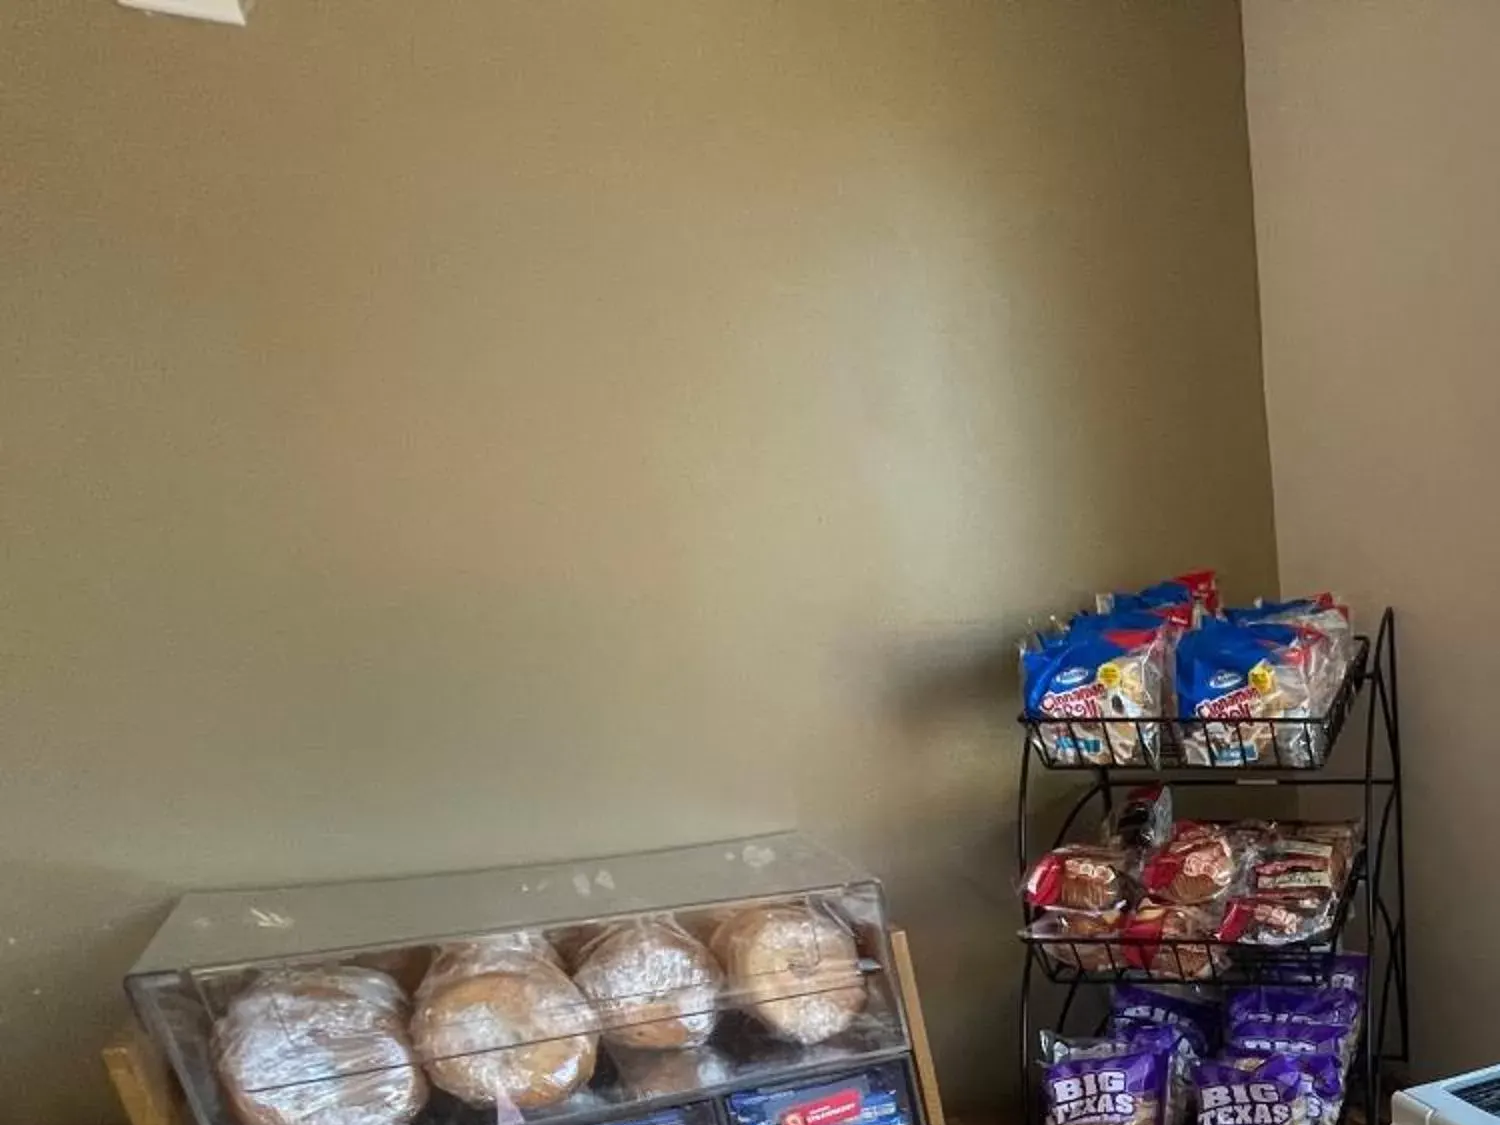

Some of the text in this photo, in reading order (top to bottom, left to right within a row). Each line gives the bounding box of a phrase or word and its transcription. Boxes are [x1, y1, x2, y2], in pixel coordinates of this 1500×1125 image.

[1053, 1070, 1126, 1103] BIG
[1200, 1083, 1279, 1111] BIG
[1052, 1092, 1135, 1125] TEXAS
